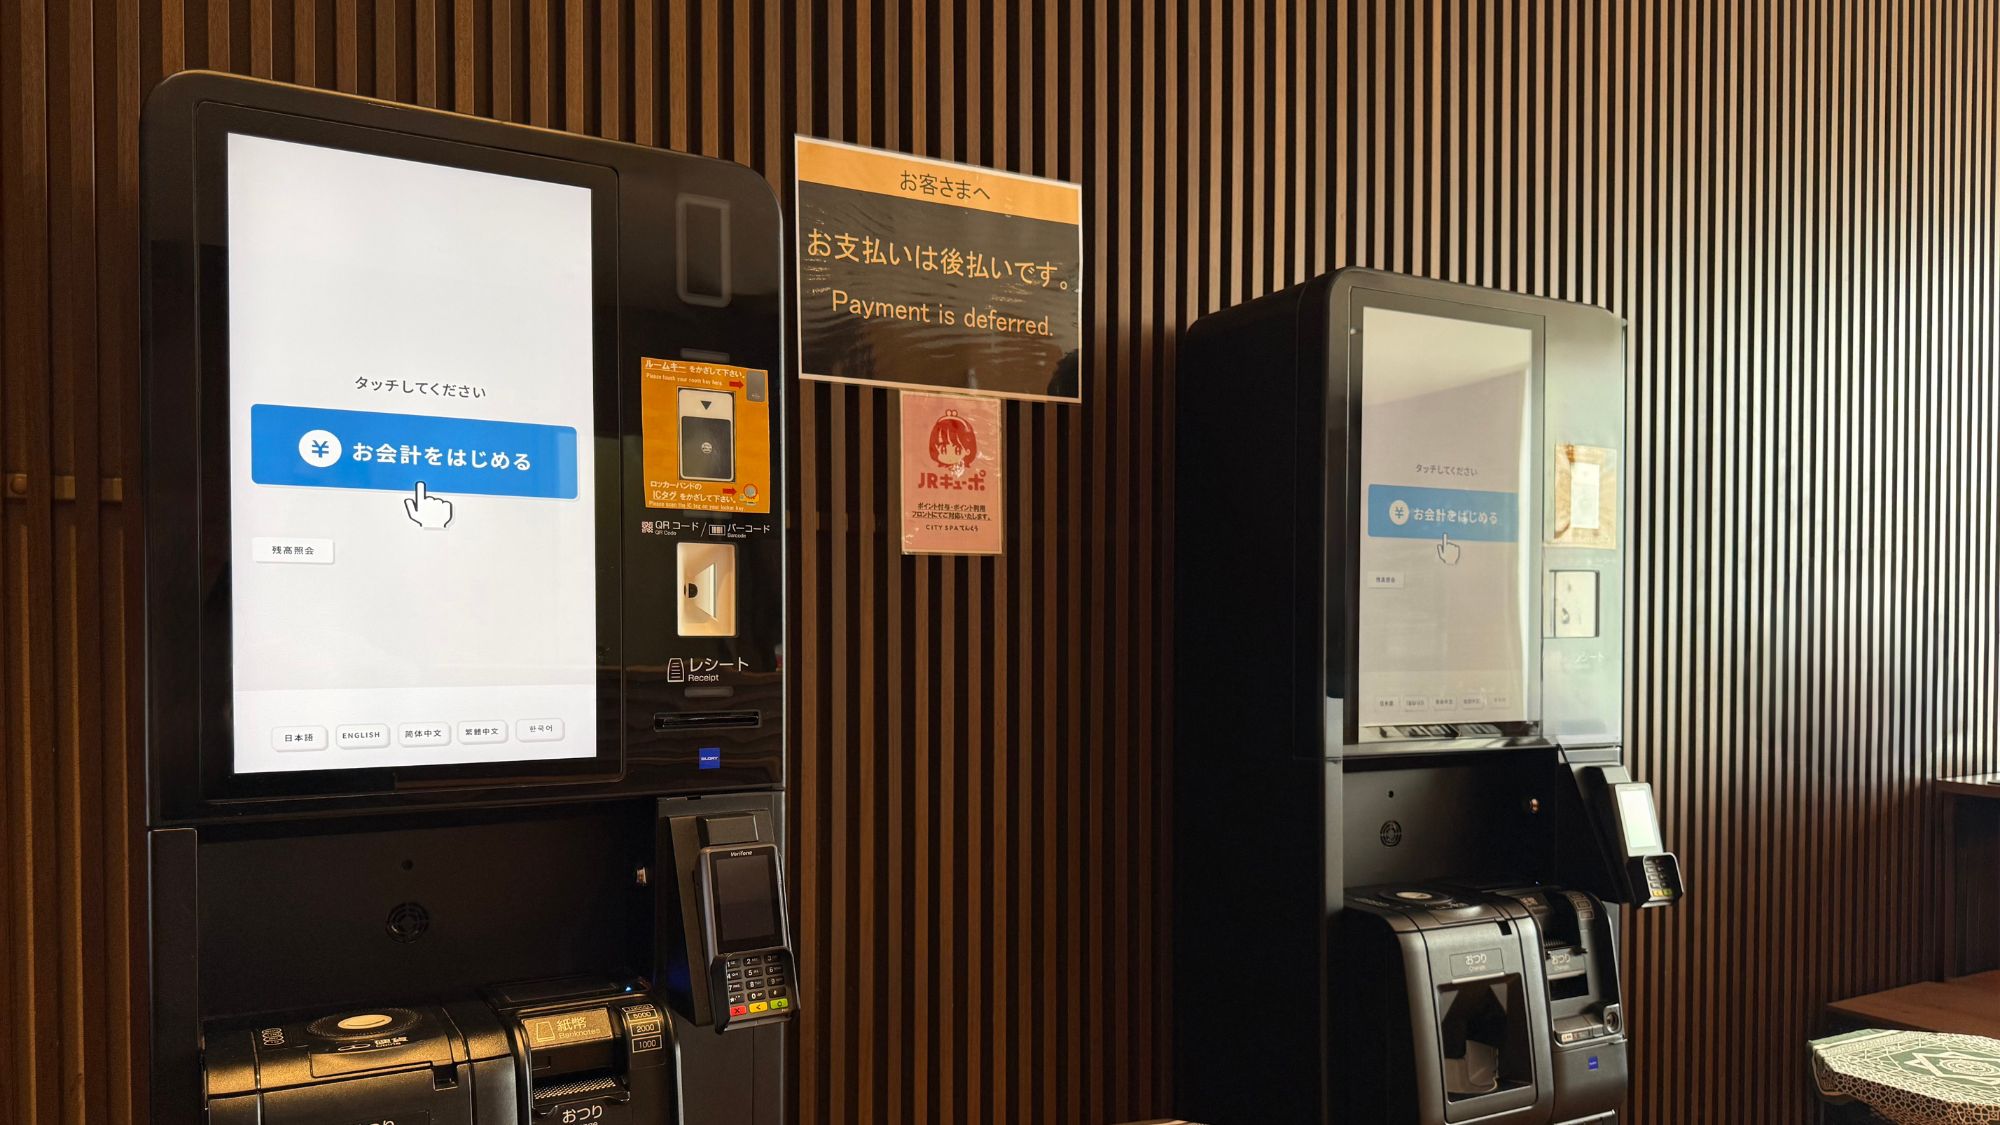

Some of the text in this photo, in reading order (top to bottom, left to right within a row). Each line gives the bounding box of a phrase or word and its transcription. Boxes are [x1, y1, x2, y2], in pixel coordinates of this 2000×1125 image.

[900, 170, 991, 200] お客さまへ
[807, 228, 1068, 290] お支払いは後払いです。
[832, 289, 1054, 337] Payment is deferred.
[645, 360, 687, 372] ルームキー
[354, 375, 487, 399] タッチしてください
[352, 442, 532, 471] お会計をはじめる
[1415, 463, 1478, 477] タッチしてください
[918, 469, 987, 492] JRキューポ
[653, 490, 677, 501] ICタグ
[727, 523, 771, 534] バーコード
[271, 545, 315, 556] 残高照会
[690, 656, 749, 672] レシート
[688, 674, 720, 682] Receipt
[284, 733, 314, 743] 日本語
[342, 731, 381, 739] ENGLISH
[404, 729, 442, 739] 简体中文
[1465, 953, 1487, 966] おつり
[556, 1017, 587, 1032] 紙幣
[636, 1024, 655, 1033] 2000
[559, 1028, 600, 1039] Banknotes
[638, 1040, 657, 1049] 1000
[562, 1104, 603, 1124] おつり
